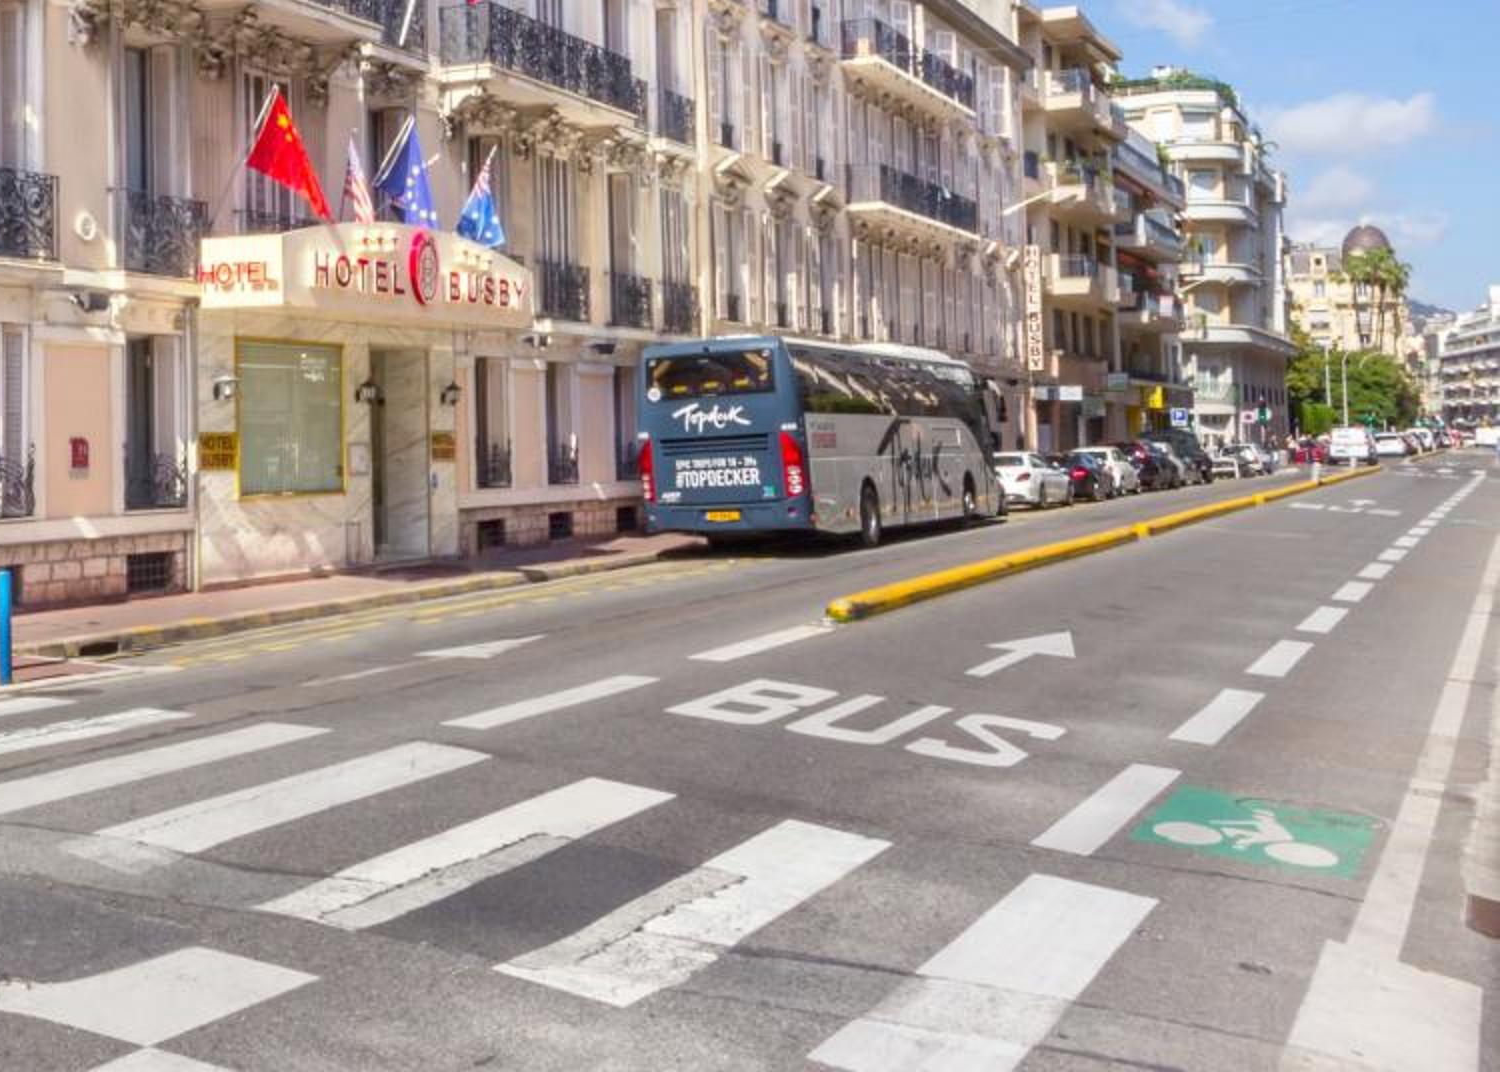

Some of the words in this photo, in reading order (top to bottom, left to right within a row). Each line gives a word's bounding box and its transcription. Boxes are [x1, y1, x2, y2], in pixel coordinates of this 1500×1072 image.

[197, 261, 271, 285] HOTEL
[314, 249, 405, 295] HOTEL
[449, 270, 525, 307] BUSBY
[200, 436, 234, 450] HOTEL
[676, 468, 760, 488] #TOPDECKER
[664, 678, 1068, 767] BUS
